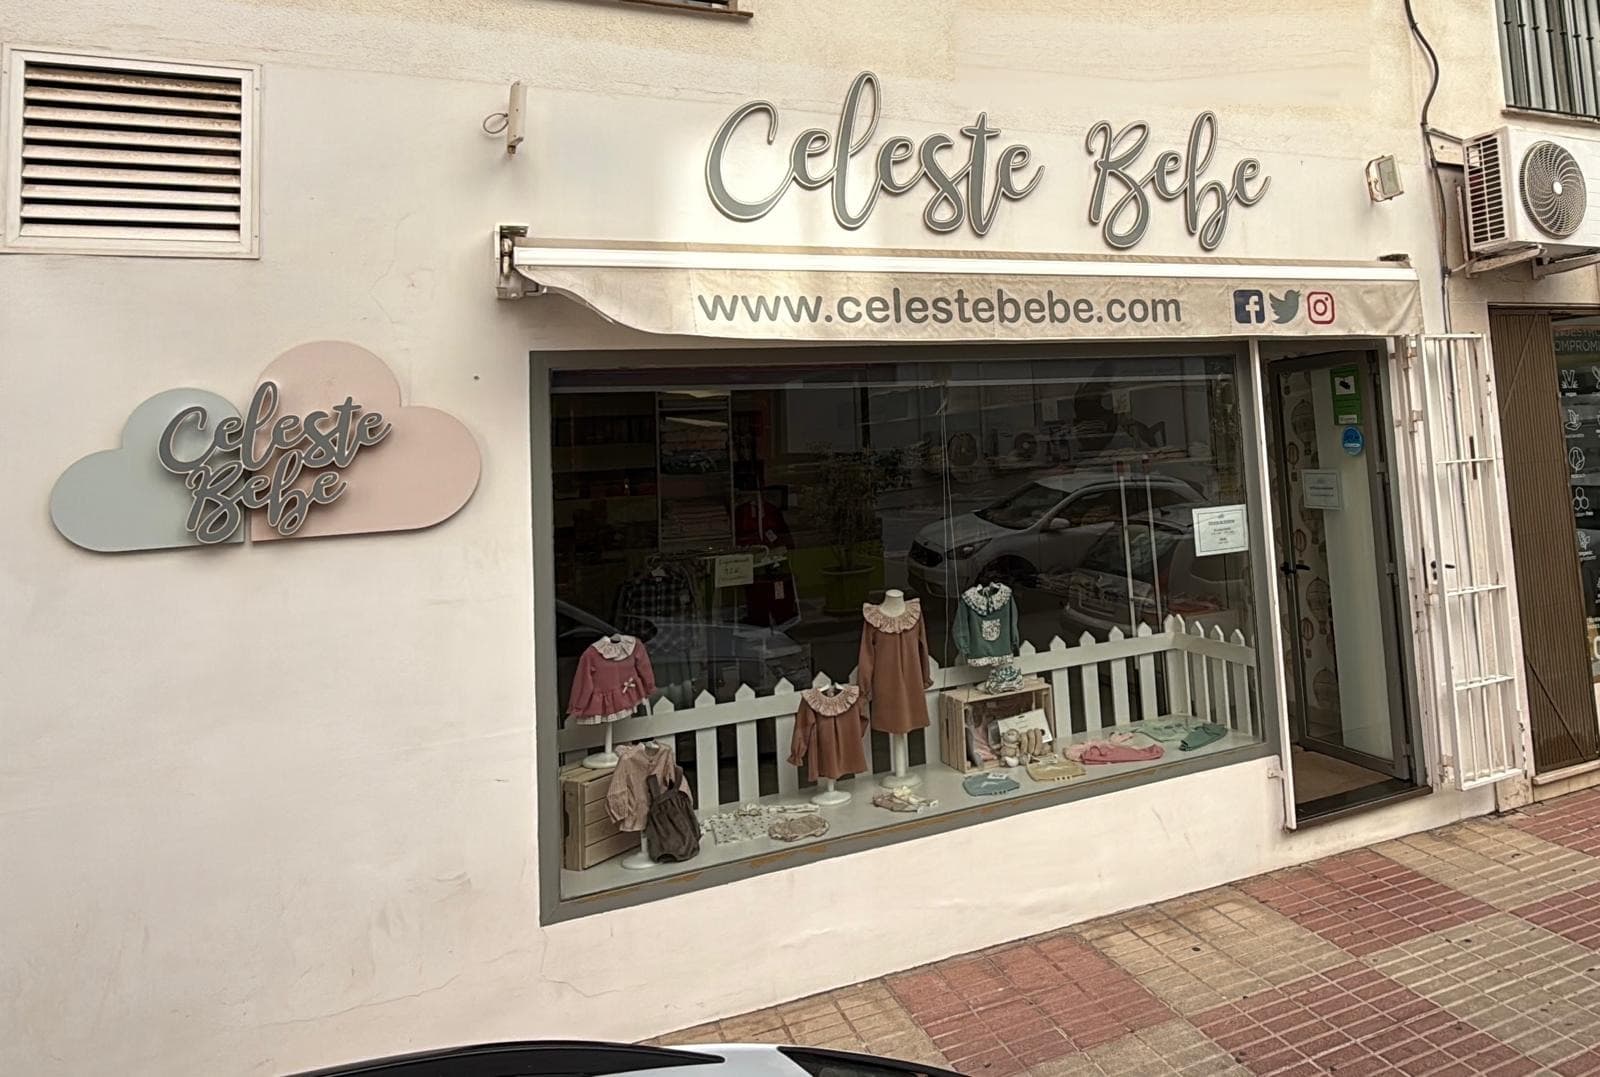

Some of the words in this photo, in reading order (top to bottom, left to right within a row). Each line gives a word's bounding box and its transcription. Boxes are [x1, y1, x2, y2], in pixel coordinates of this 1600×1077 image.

[706, 71, 1045, 237] Celeste
[1086, 110, 1272, 251] Bebe
[698, 289, 1182, 324] www.celestebebe.com
[157, 381, 392, 474] Celeste
[186, 450, 347, 544] Bebe
